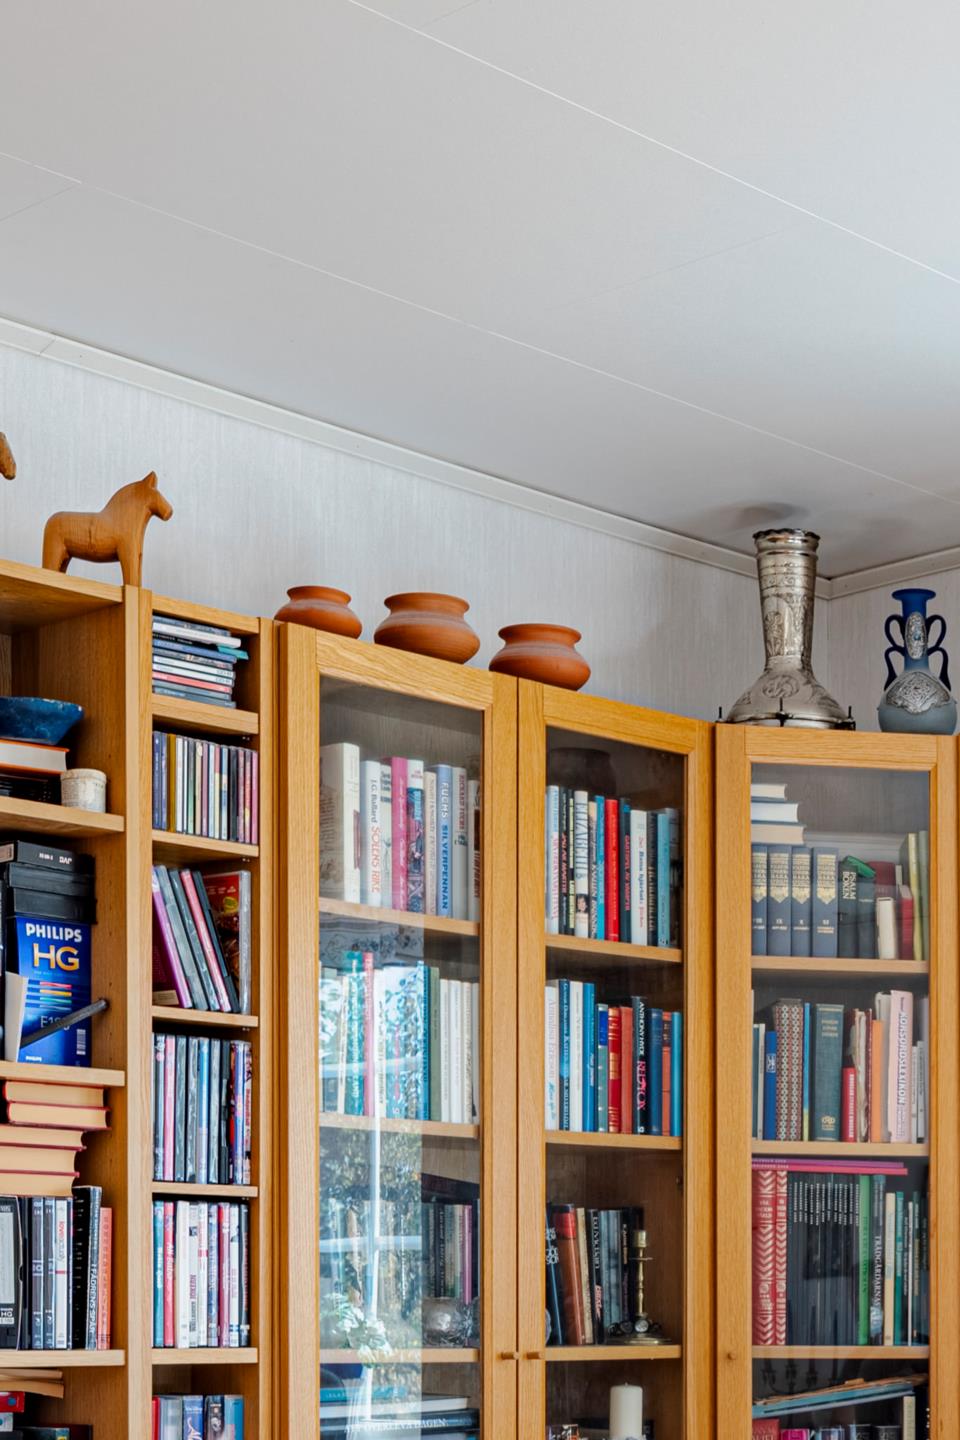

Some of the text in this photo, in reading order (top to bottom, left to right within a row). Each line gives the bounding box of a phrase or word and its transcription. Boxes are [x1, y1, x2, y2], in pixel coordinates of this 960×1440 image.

[370, 794, 378, 823] Ballard
[441, 782, 449, 818] FUCHS
[372, 870, 382, 893] RIKE
[849, 871, 857, 900] PSALM
[25, 922, 82, 943] PHILIPS
[33, 942, 80, 971] HG
[897, 1012, 908, 1105] KORSORDSLEXIKON
[874, 1235, 883, 1306] TRÄDGÅRDARNAS
